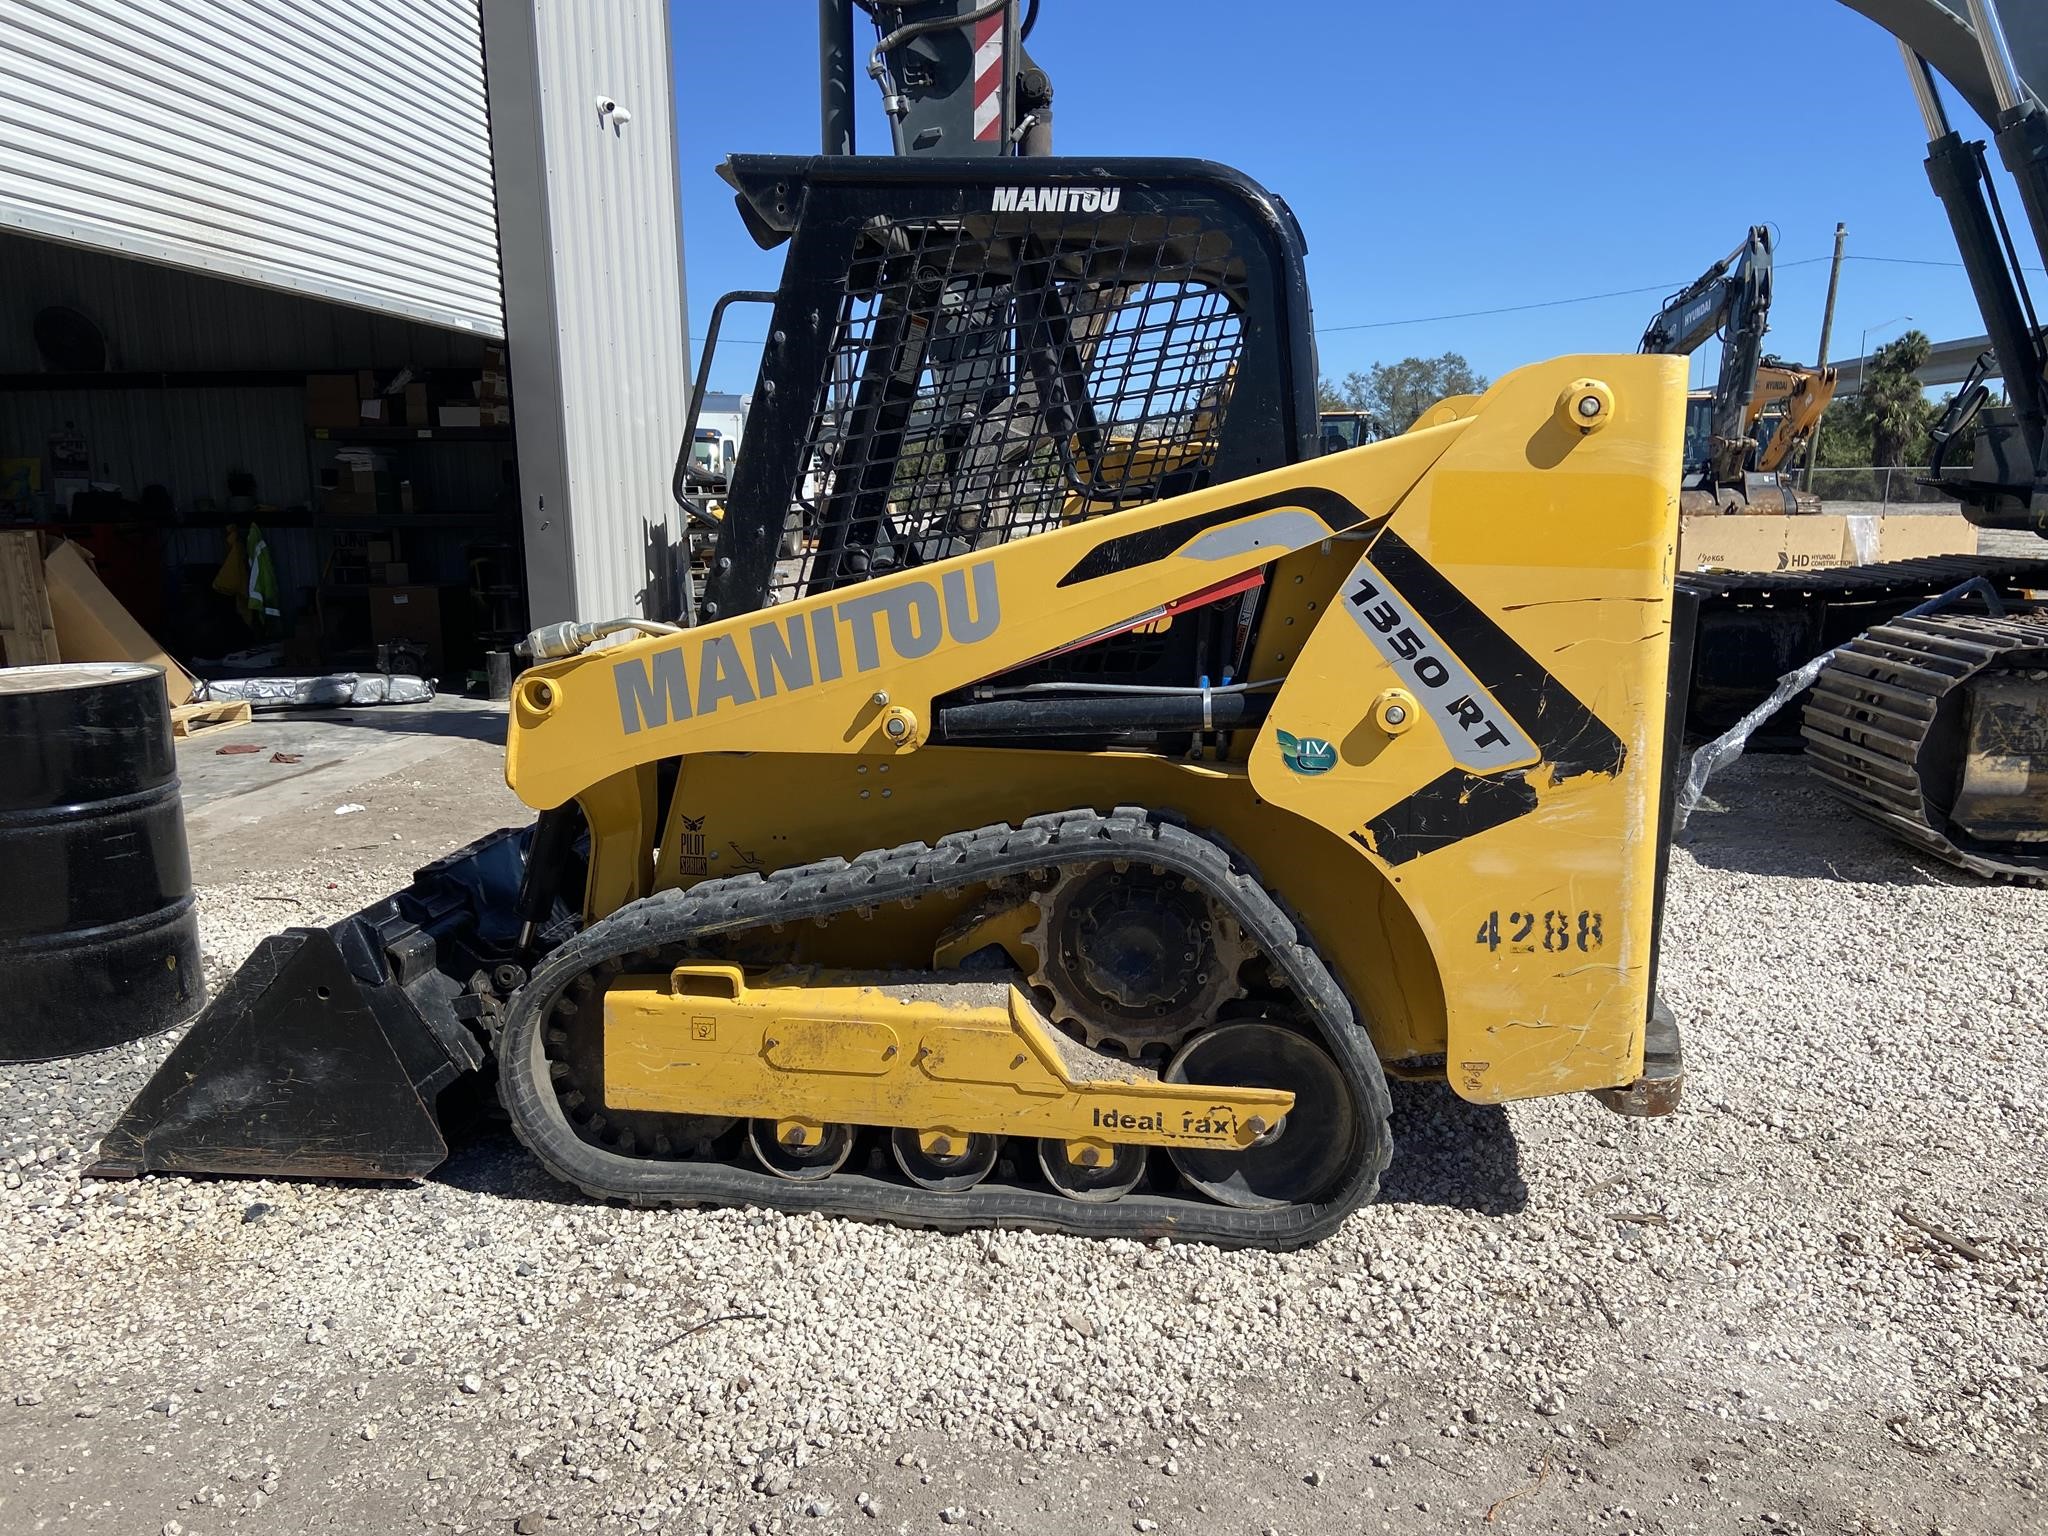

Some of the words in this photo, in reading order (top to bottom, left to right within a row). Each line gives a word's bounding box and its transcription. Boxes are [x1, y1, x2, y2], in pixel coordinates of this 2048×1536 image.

[991, 186, 1121, 213] MANITOU
[1684, 299, 1712, 326] HYUNDAI
[1765, 381, 1788, 390] HYUNDAI
[1791, 554, 1810, 567] HD
[1810, 559, 1853, 567] CONSTRUCTION
[612, 560, 1001, 735] MANITOU
[1350, 578, 1450, 688] 1350
[1445, 694, 1511, 749] RT
[681, 833, 706, 855] PILOT
[1475, 910, 1603, 953] 4288
[1093, 1107, 1163, 1132] Ideal
[1174, 1111, 1230, 1135] rax
